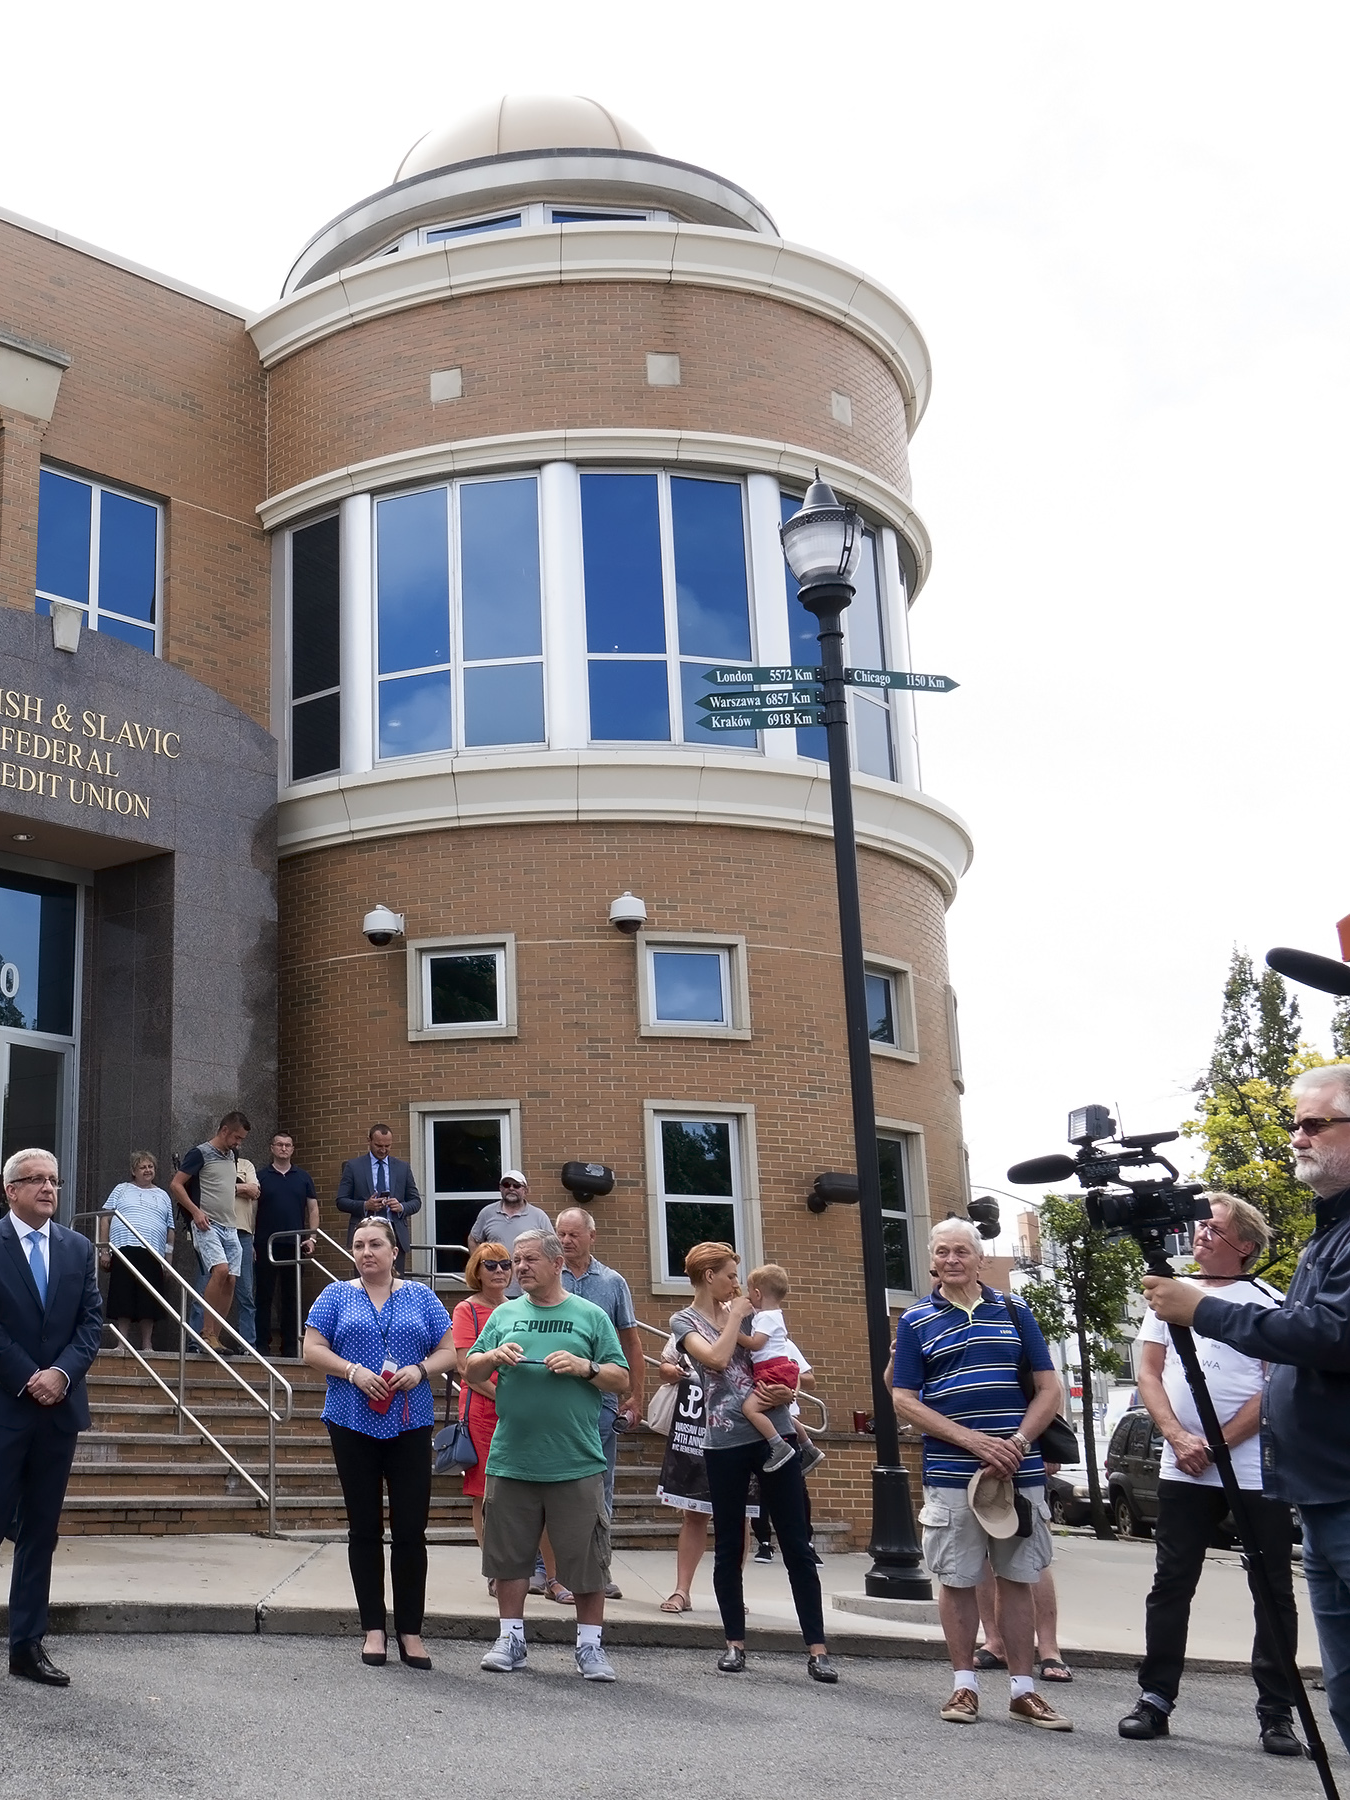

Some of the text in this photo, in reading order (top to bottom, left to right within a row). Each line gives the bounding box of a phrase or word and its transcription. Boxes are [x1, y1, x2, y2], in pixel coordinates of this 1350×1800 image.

[716, 668, 813, 683] London 5572 Km
[853, 670, 945, 689] Chicago 1150 Km
[709, 692, 811, 709] Warszawa 6857 Km
[711, 712, 812, 728] Kraków 6918 Km
[51, 703, 74, 733] &
[81, 710, 181, 759] SLAVIC
[0, 725, 120, 778] FEDERAL
[68, 778, 151, 820] UNION
[528, 1320, 574, 1333] PUMA
[697, 1426, 706, 1437] UP
